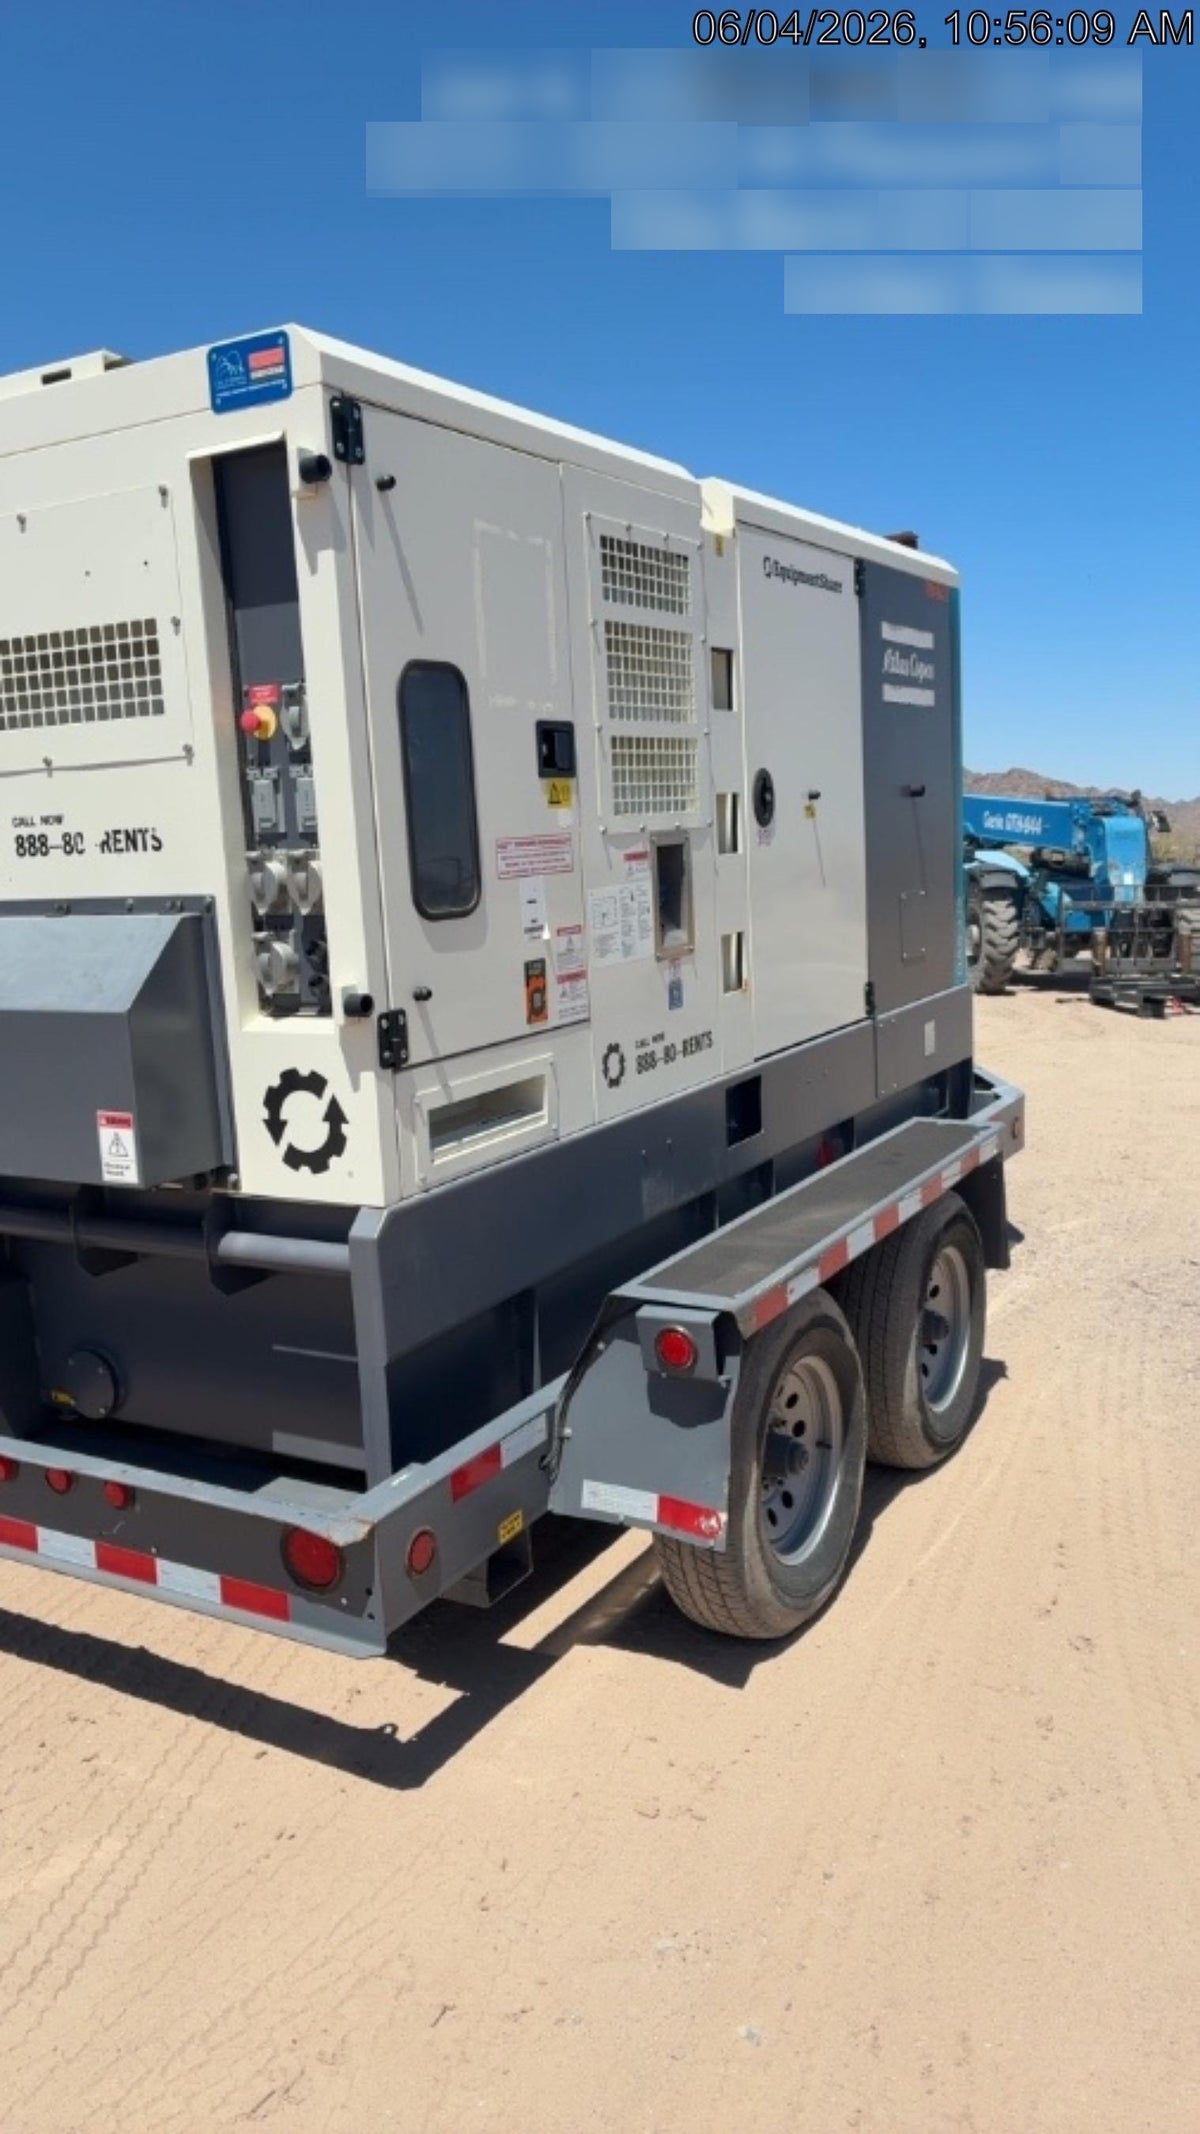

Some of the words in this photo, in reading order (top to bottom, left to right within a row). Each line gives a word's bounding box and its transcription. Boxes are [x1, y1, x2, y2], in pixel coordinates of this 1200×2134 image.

[773, 560, 842, 593] EquipmentShare
[882, 649, 909, 677] Atlas
[12, 816, 35, 828] CALL
[40, 814, 63, 826] NOW
